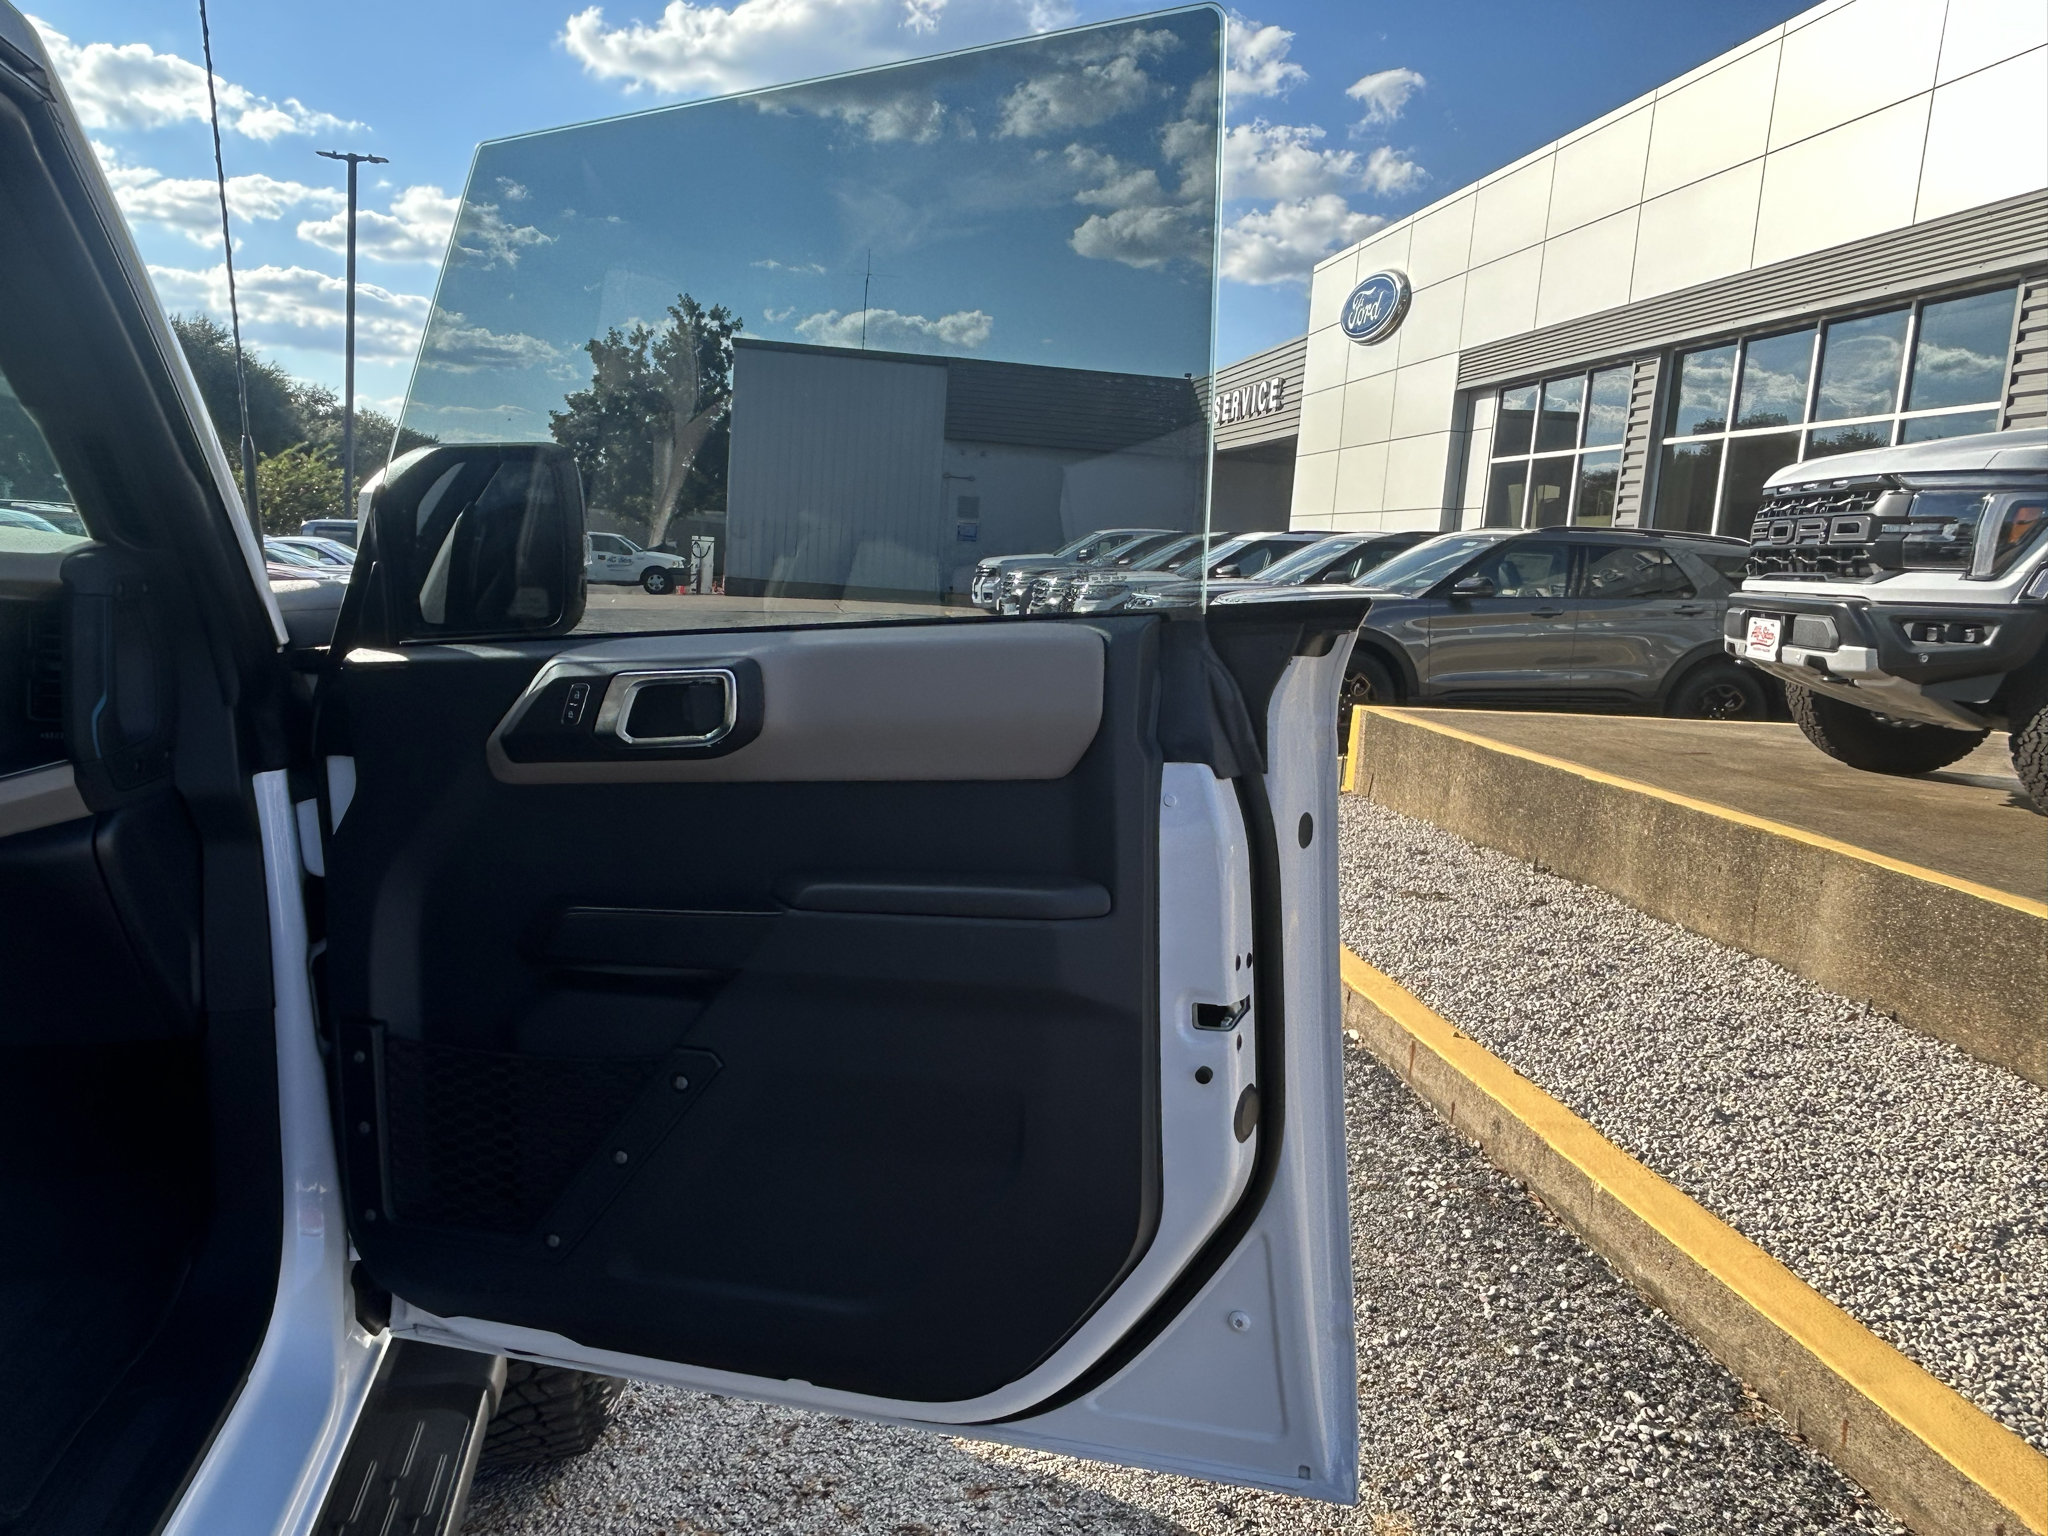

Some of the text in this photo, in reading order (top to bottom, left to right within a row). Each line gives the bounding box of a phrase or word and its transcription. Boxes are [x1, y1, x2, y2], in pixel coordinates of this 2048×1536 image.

[1348, 286, 1383, 330] Ford
[1213, 378, 1281, 425] SERVICE
[1751, 516, 1871, 545] FORD
